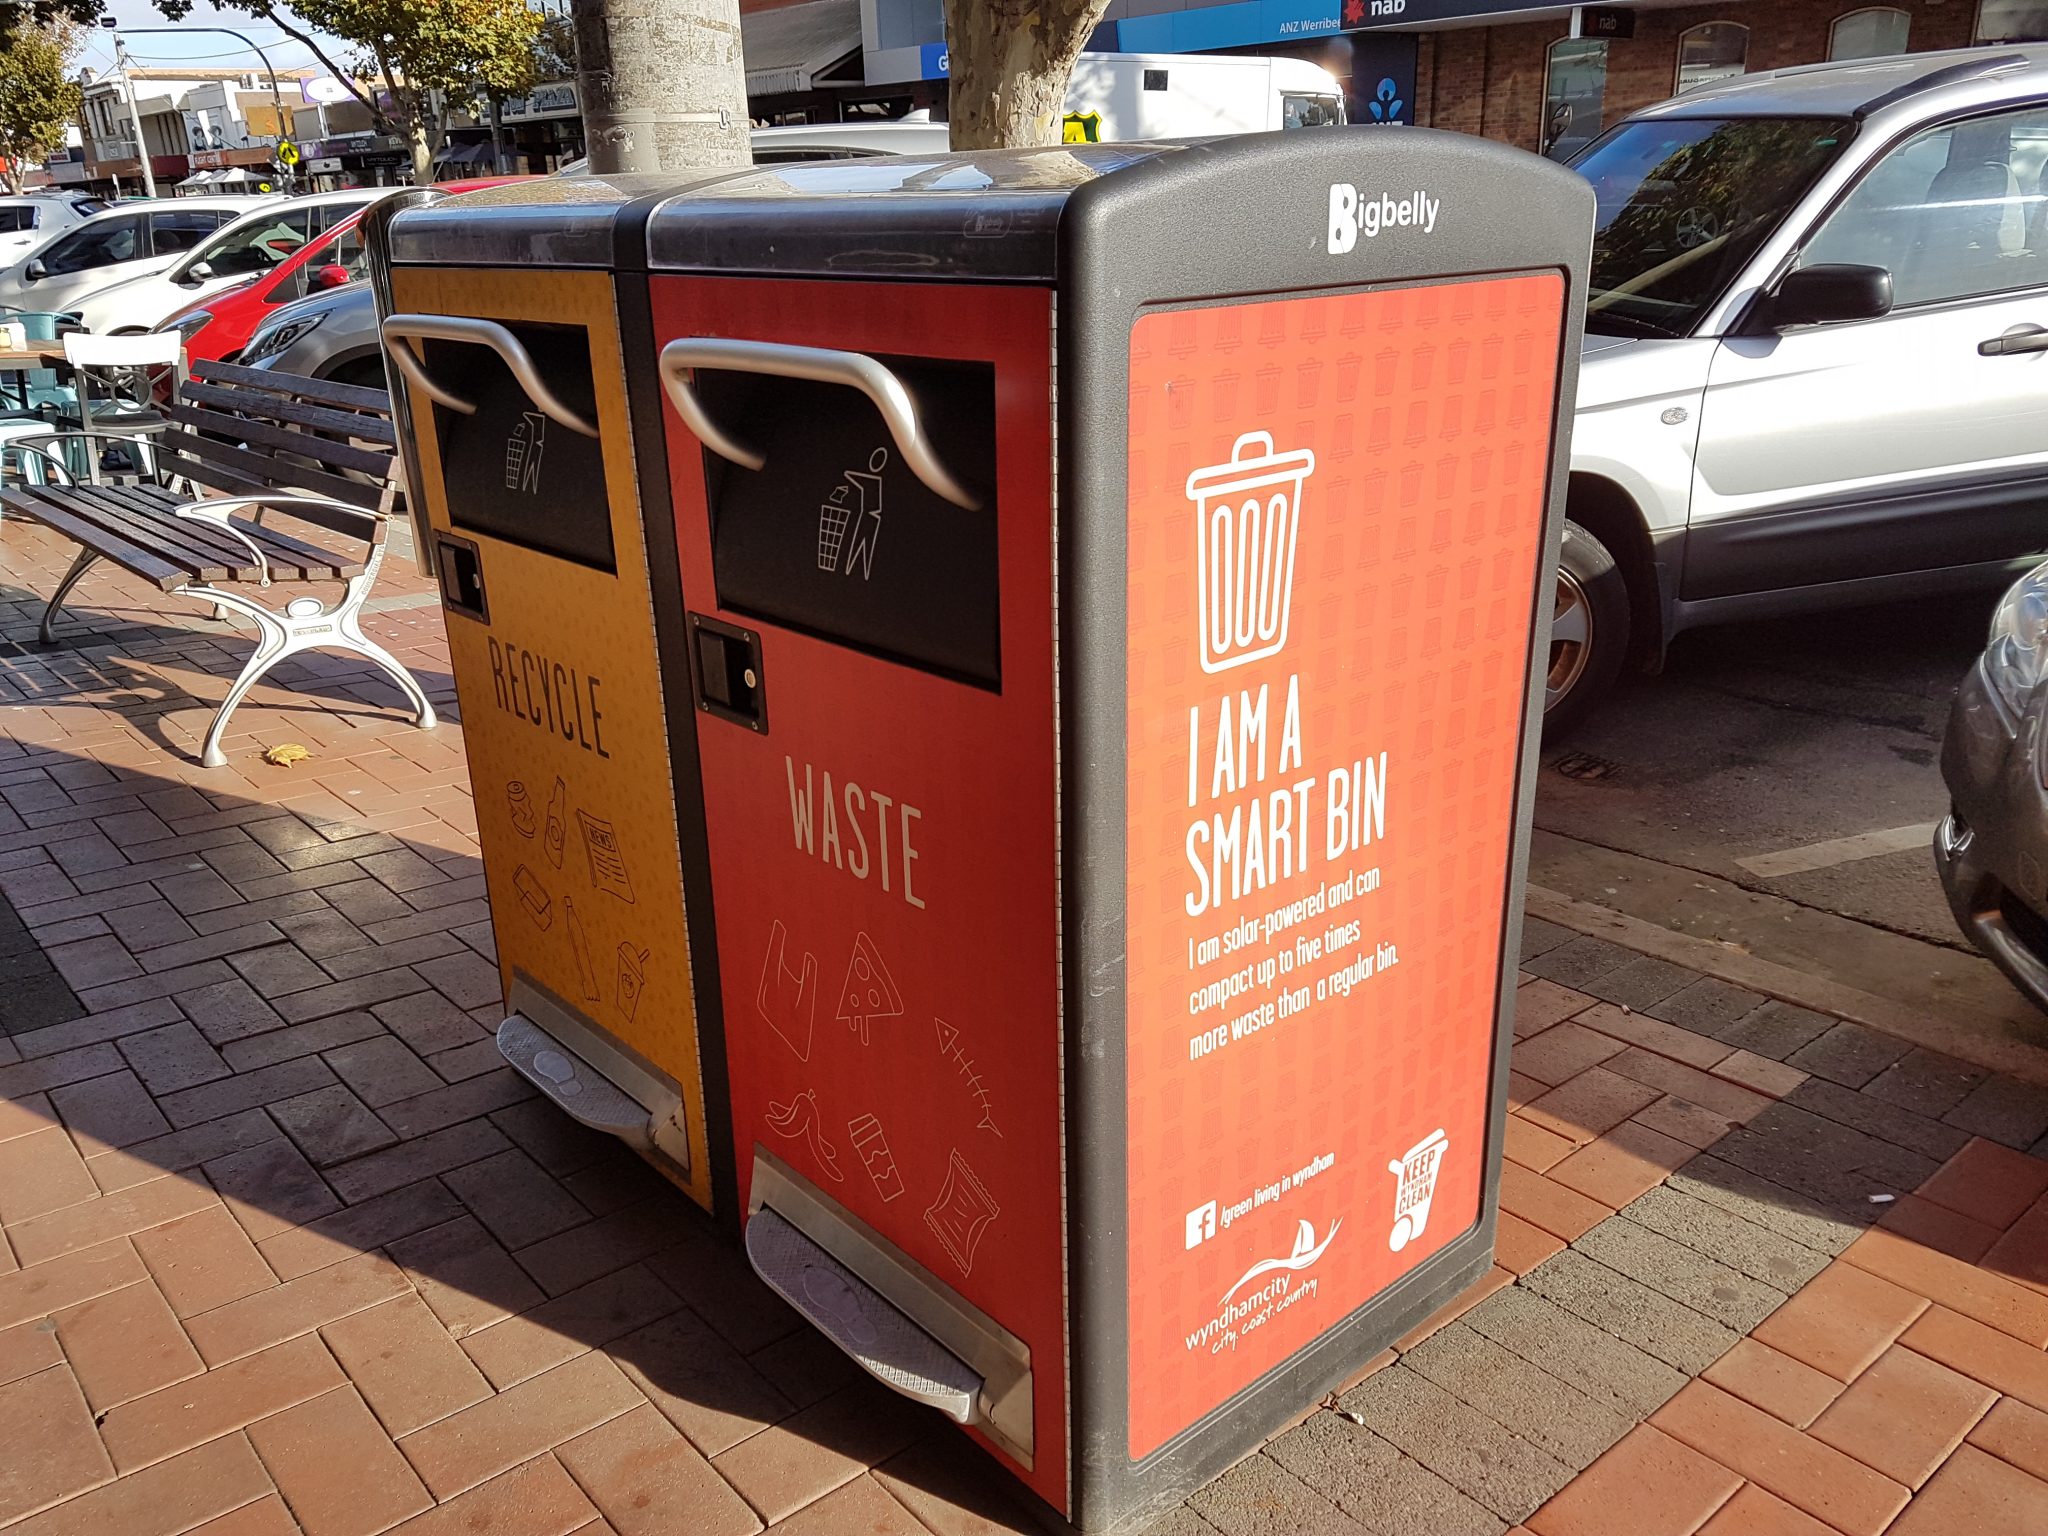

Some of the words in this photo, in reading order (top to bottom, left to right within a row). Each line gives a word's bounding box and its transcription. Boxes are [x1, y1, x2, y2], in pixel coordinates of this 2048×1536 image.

[1279, 20, 1299, 34] ANZ
[1599, 14, 1617, 30] nab
[1327, 182, 1440, 254] Bigbelly
[488, 636, 610, 760] RECYCLE
[1188, 706, 1199, 808] I
[1211, 683, 1269, 799] AM
[1278, 674, 1302, 774] A
[590, 825, 615, 850] NEWS
[785, 755, 925, 910] WASTE
[1185, 777, 1316, 917] SMART
[1326, 751, 1388, 861] BIN
[1188, 937, 1194, 970] I
[1197, 936, 1220, 966] am
[1222, 881, 1325, 955] solar-powered
[1327, 869, 1353, 909] and
[1355, 867, 1380, 896] can
[1189, 963, 1255, 1015] compact
[1257, 957, 1276, 990] up
[1278, 949, 1294, 974] to
[1295, 935, 1322, 967] five
[1323, 919, 1361, 954] times
[1189, 1024, 1228, 1061] more
[1230, 1002, 1275, 1041] waste
[1277, 986, 1311, 1019] than
[1316, 978, 1326, 1001] a
[1328, 952, 1375, 997] regular
[1377, 941, 1399, 972] bin.
[1220, 1198, 1253, 1229] /green
[1253, 1182, 1281, 1208] living
[1281, 1174, 1291, 1193] in
[1292, 1152, 1335, 1188] wyndham
[1398, 1182, 1432, 1215] CLEAN
[1402, 1148, 1436, 1187] KEEP
[1185, 1272, 1291, 1351] wyndhamcity
[1276, 1278, 1318, 1314] country
